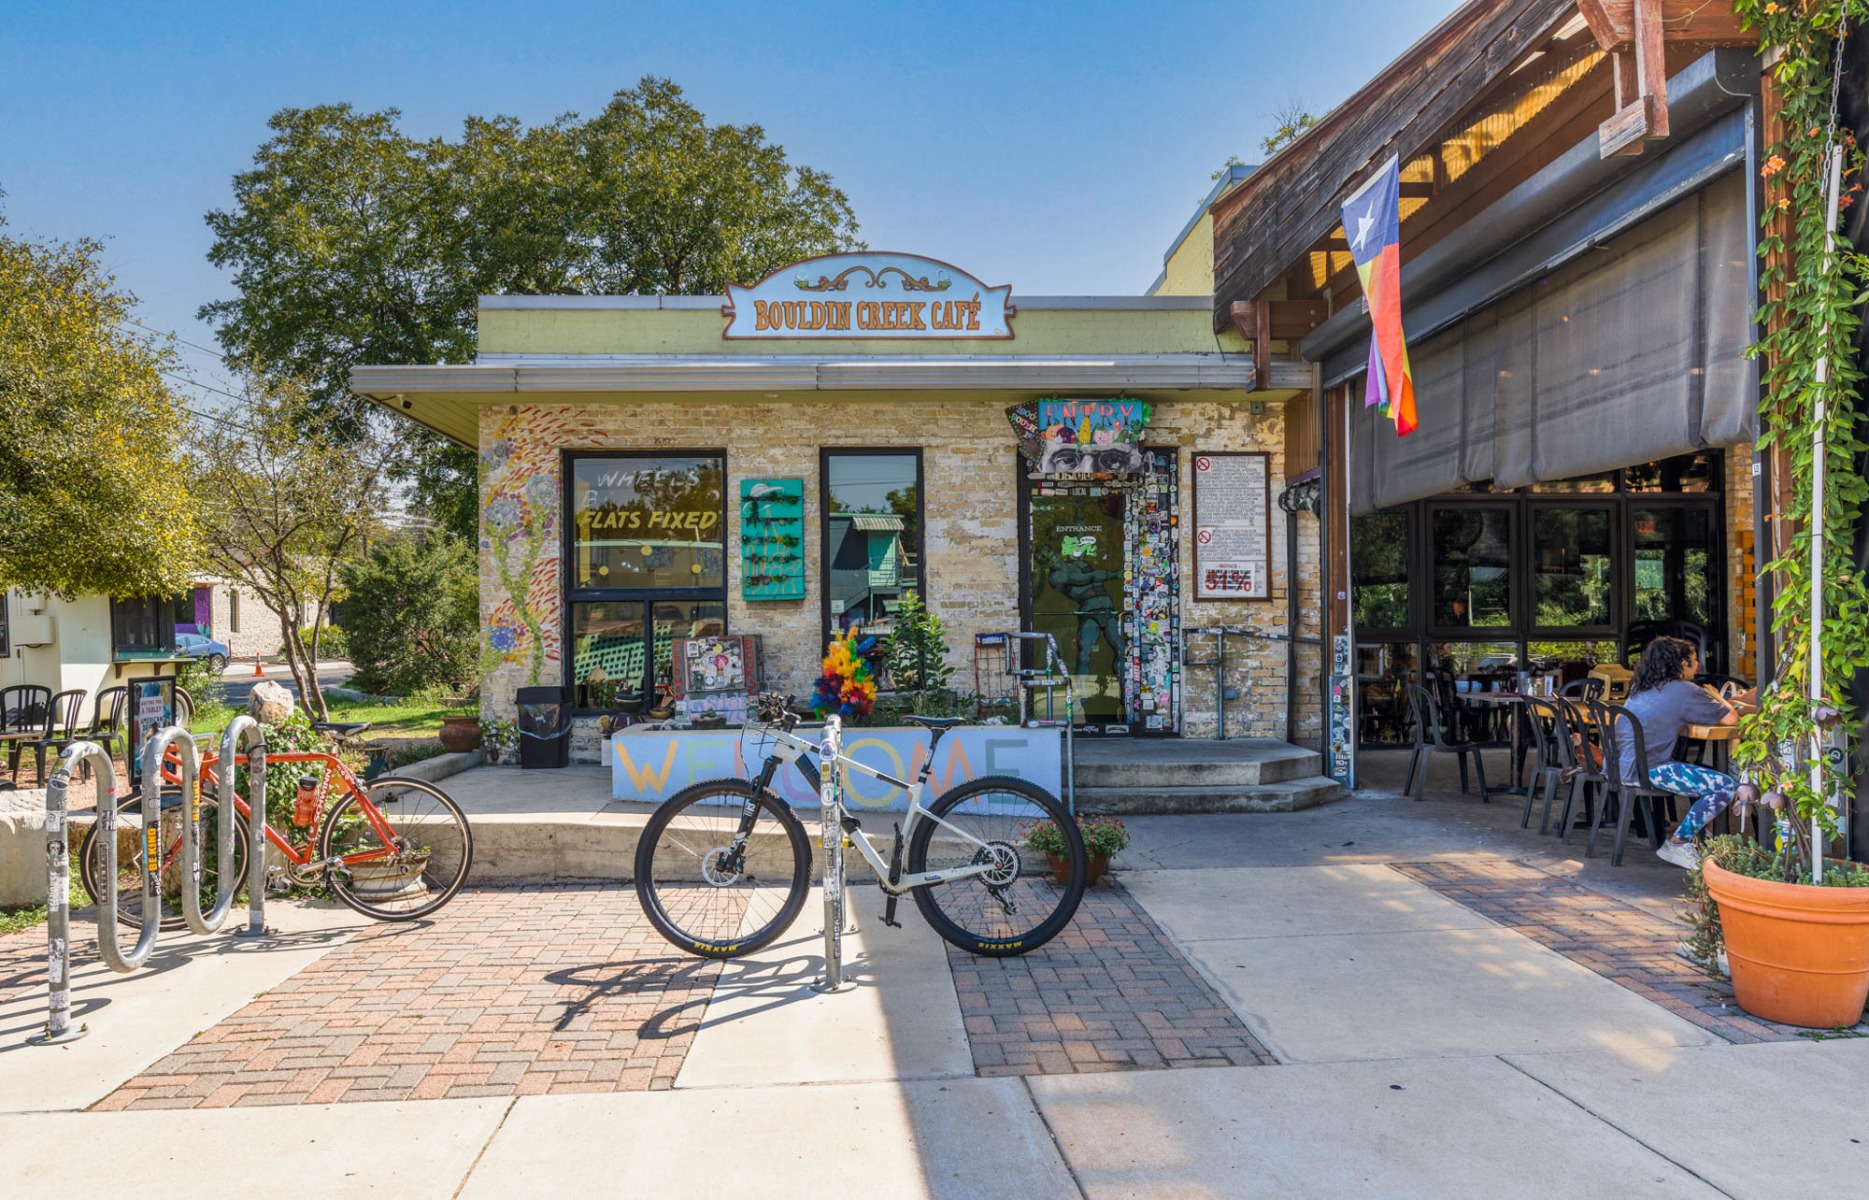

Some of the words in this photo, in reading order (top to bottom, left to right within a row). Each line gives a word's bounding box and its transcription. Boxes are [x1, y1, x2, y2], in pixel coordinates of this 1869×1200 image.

[754, 300, 851, 330] BOULDIN
[857, 300, 926, 330] CREEK
[931, 292, 981, 330] CAFÉ
[1010, 412, 1038, 433] SOUTH
[1046, 404, 1134, 425] ENTRY
[598, 469, 700, 487] WHEELS
[578, 511, 641, 529] FLATS
[648, 511, 718, 529] FIXED
[1205, 571, 1252, 592] 51%
[313, 768, 332, 823] SCHWINN
[147, 827, 157, 855] KIND
[148, 856, 158, 871] BE
